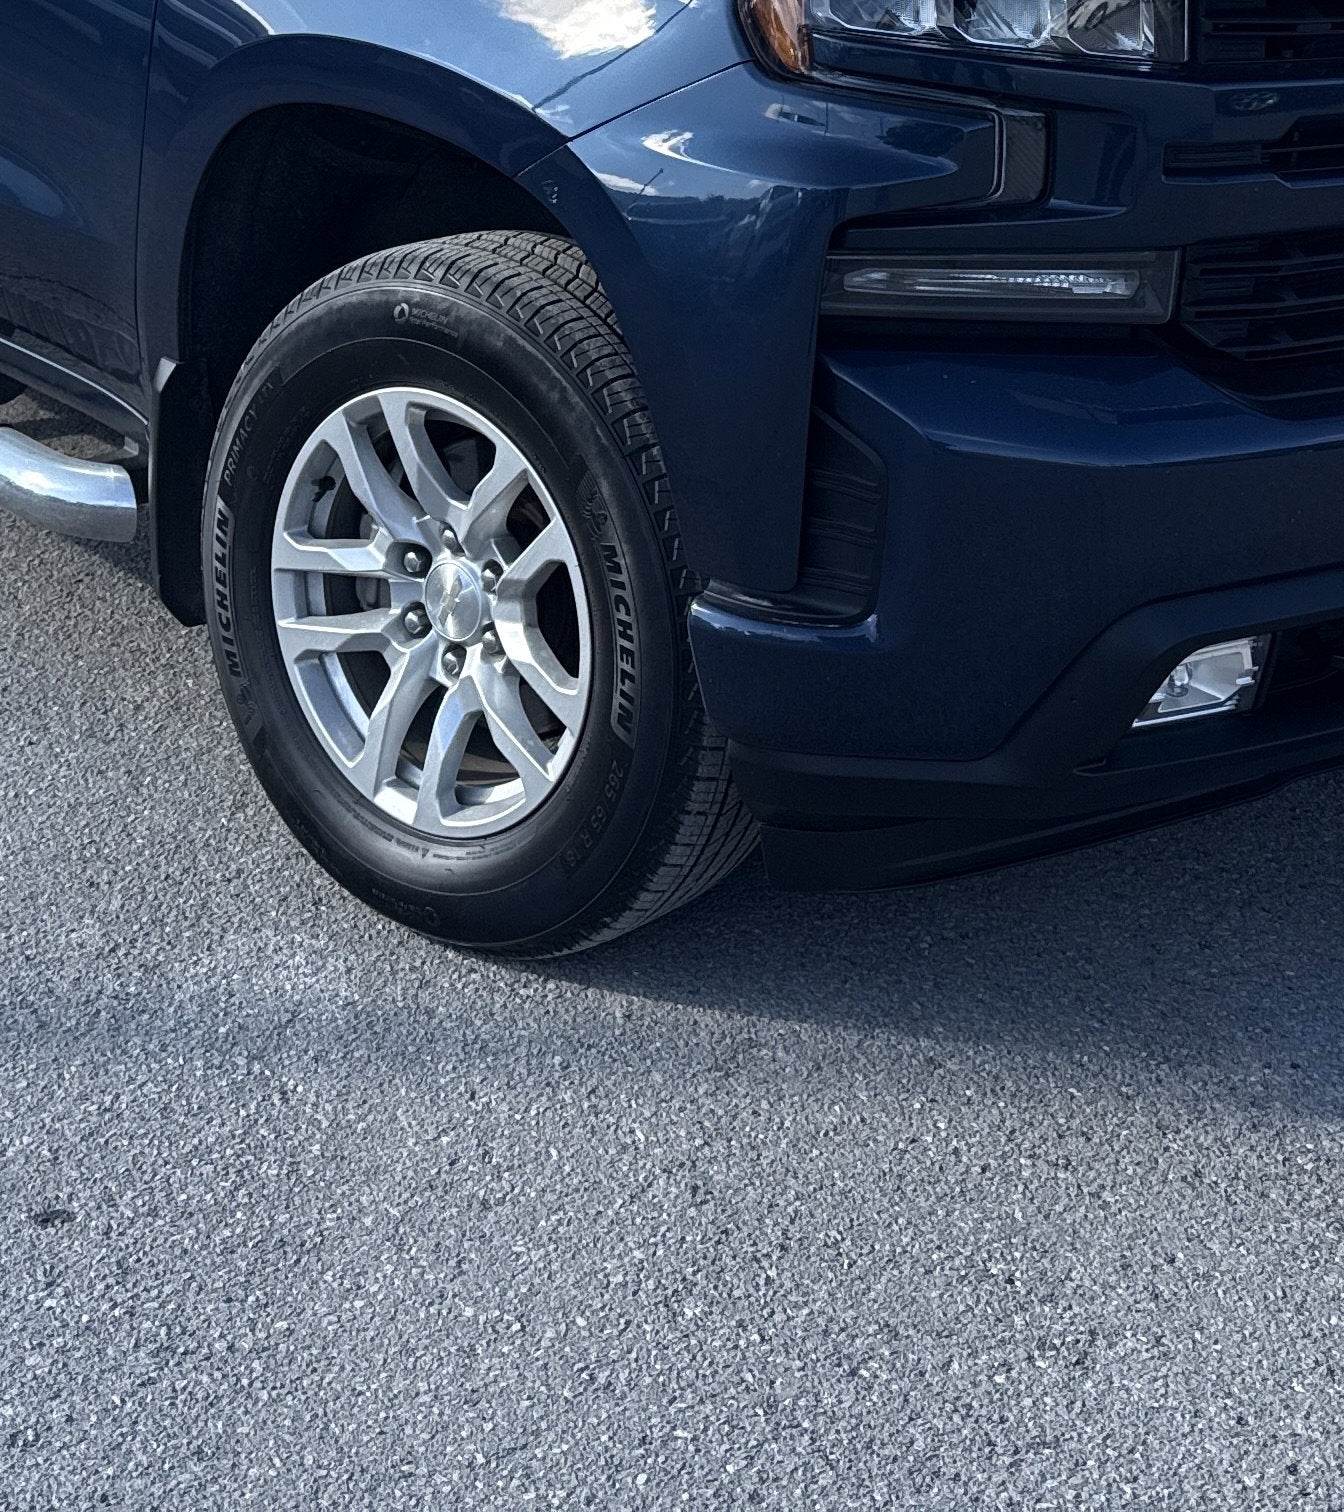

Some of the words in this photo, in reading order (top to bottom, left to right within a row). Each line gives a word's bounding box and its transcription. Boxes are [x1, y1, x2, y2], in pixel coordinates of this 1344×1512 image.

[223, 403, 258, 486] PRIMACY
[214, 508, 242, 679] MICHELIN
[601, 542, 637, 736] MICHELIN
